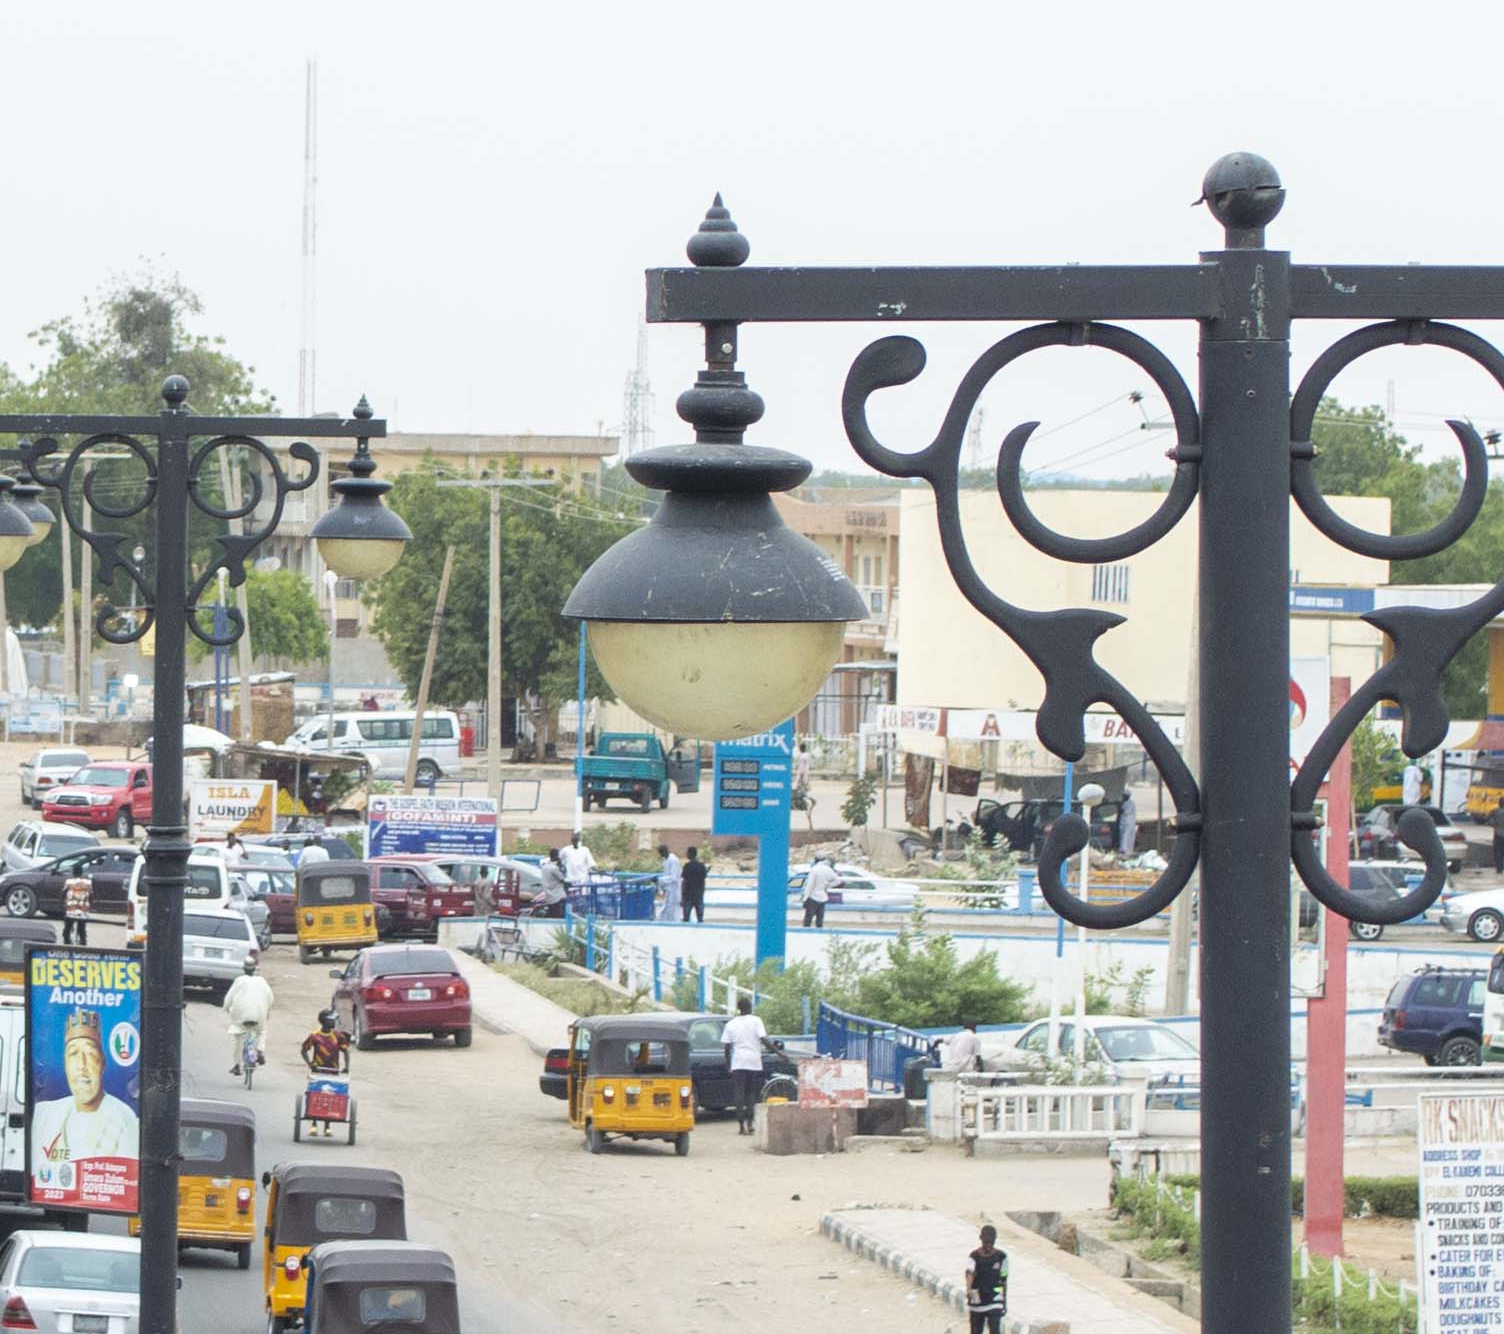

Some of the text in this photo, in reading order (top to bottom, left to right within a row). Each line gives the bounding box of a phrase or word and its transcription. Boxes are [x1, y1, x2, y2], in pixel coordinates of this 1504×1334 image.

[208, 787, 249, 798] ISLA
[198, 805, 265, 816] LAUNDRY
[32, 958, 141, 990] DESERVES
[49, 987, 124, 1007] Another
[1462, 1149, 1481, 1160] SHOP
[1443, 1167, 1451, 1178] EL
[1427, 1201, 1503, 1215] PRODUCTS AND
[1438, 1218, 1485, 1230] TRAINING
[1473, 1234, 1488, 1245] AND
[1439, 1250, 1471, 1262] CATER
[1474, 1250, 1493, 1262] FOR
[1438, 1266, 1475, 1277] BAKING
[1438, 1282, 1487, 1294] BIRTHDAY
[1440, 1297, 1500, 1310] MILKCAKES
[1440, 1313, 1502, 1326] DOUGHNUTS
